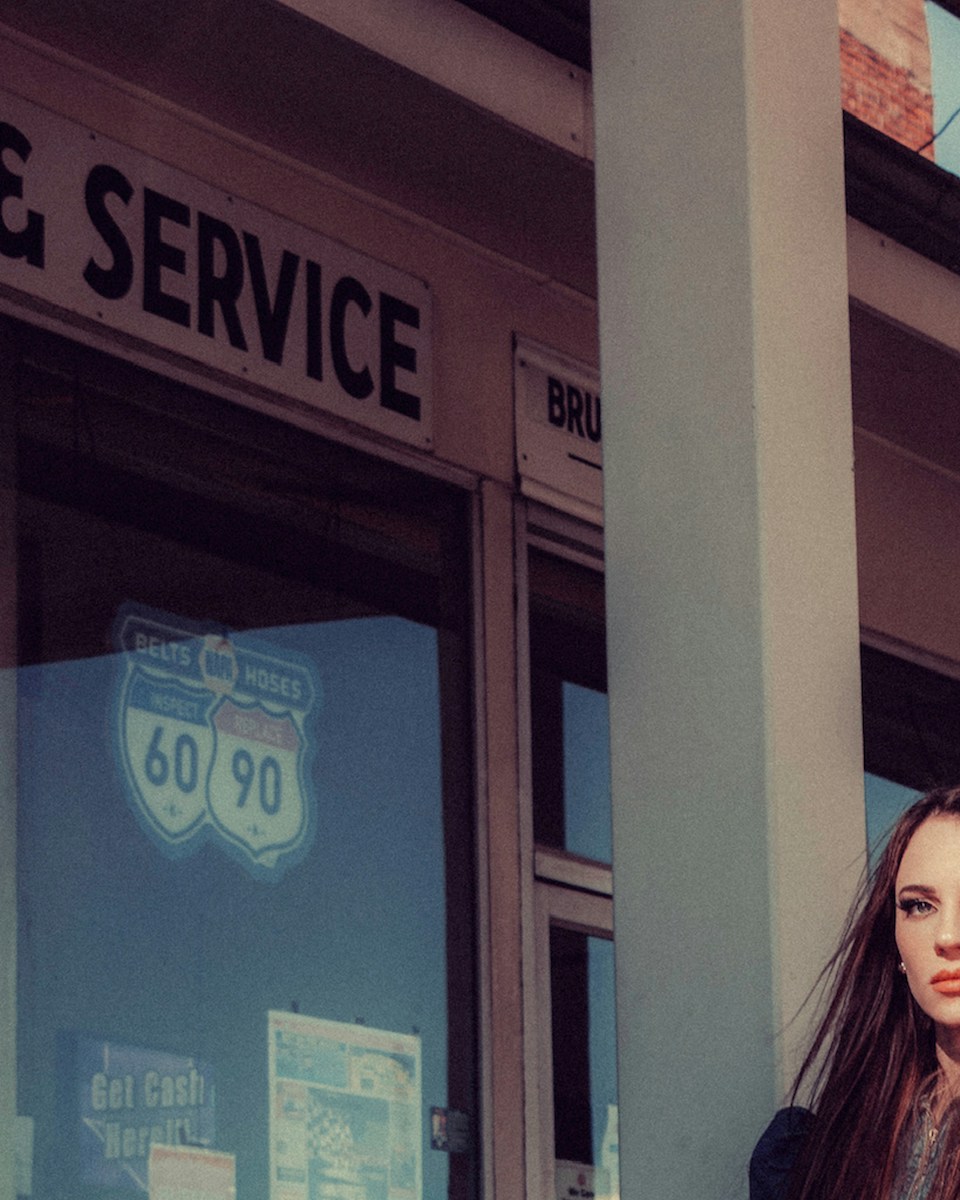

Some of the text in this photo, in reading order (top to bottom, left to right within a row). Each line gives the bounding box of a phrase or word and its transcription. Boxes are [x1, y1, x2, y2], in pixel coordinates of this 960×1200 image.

[82, 163, 422, 423] SERVICE
[547, 376, 601, 443] BRU
[135, 633, 192, 667] BELTS
[245, 664, 302, 700] HOSES
[145, 725, 199, 794] 60
[231, 748, 282, 817] 90
[91, 1068, 205, 1111] Get Cash
